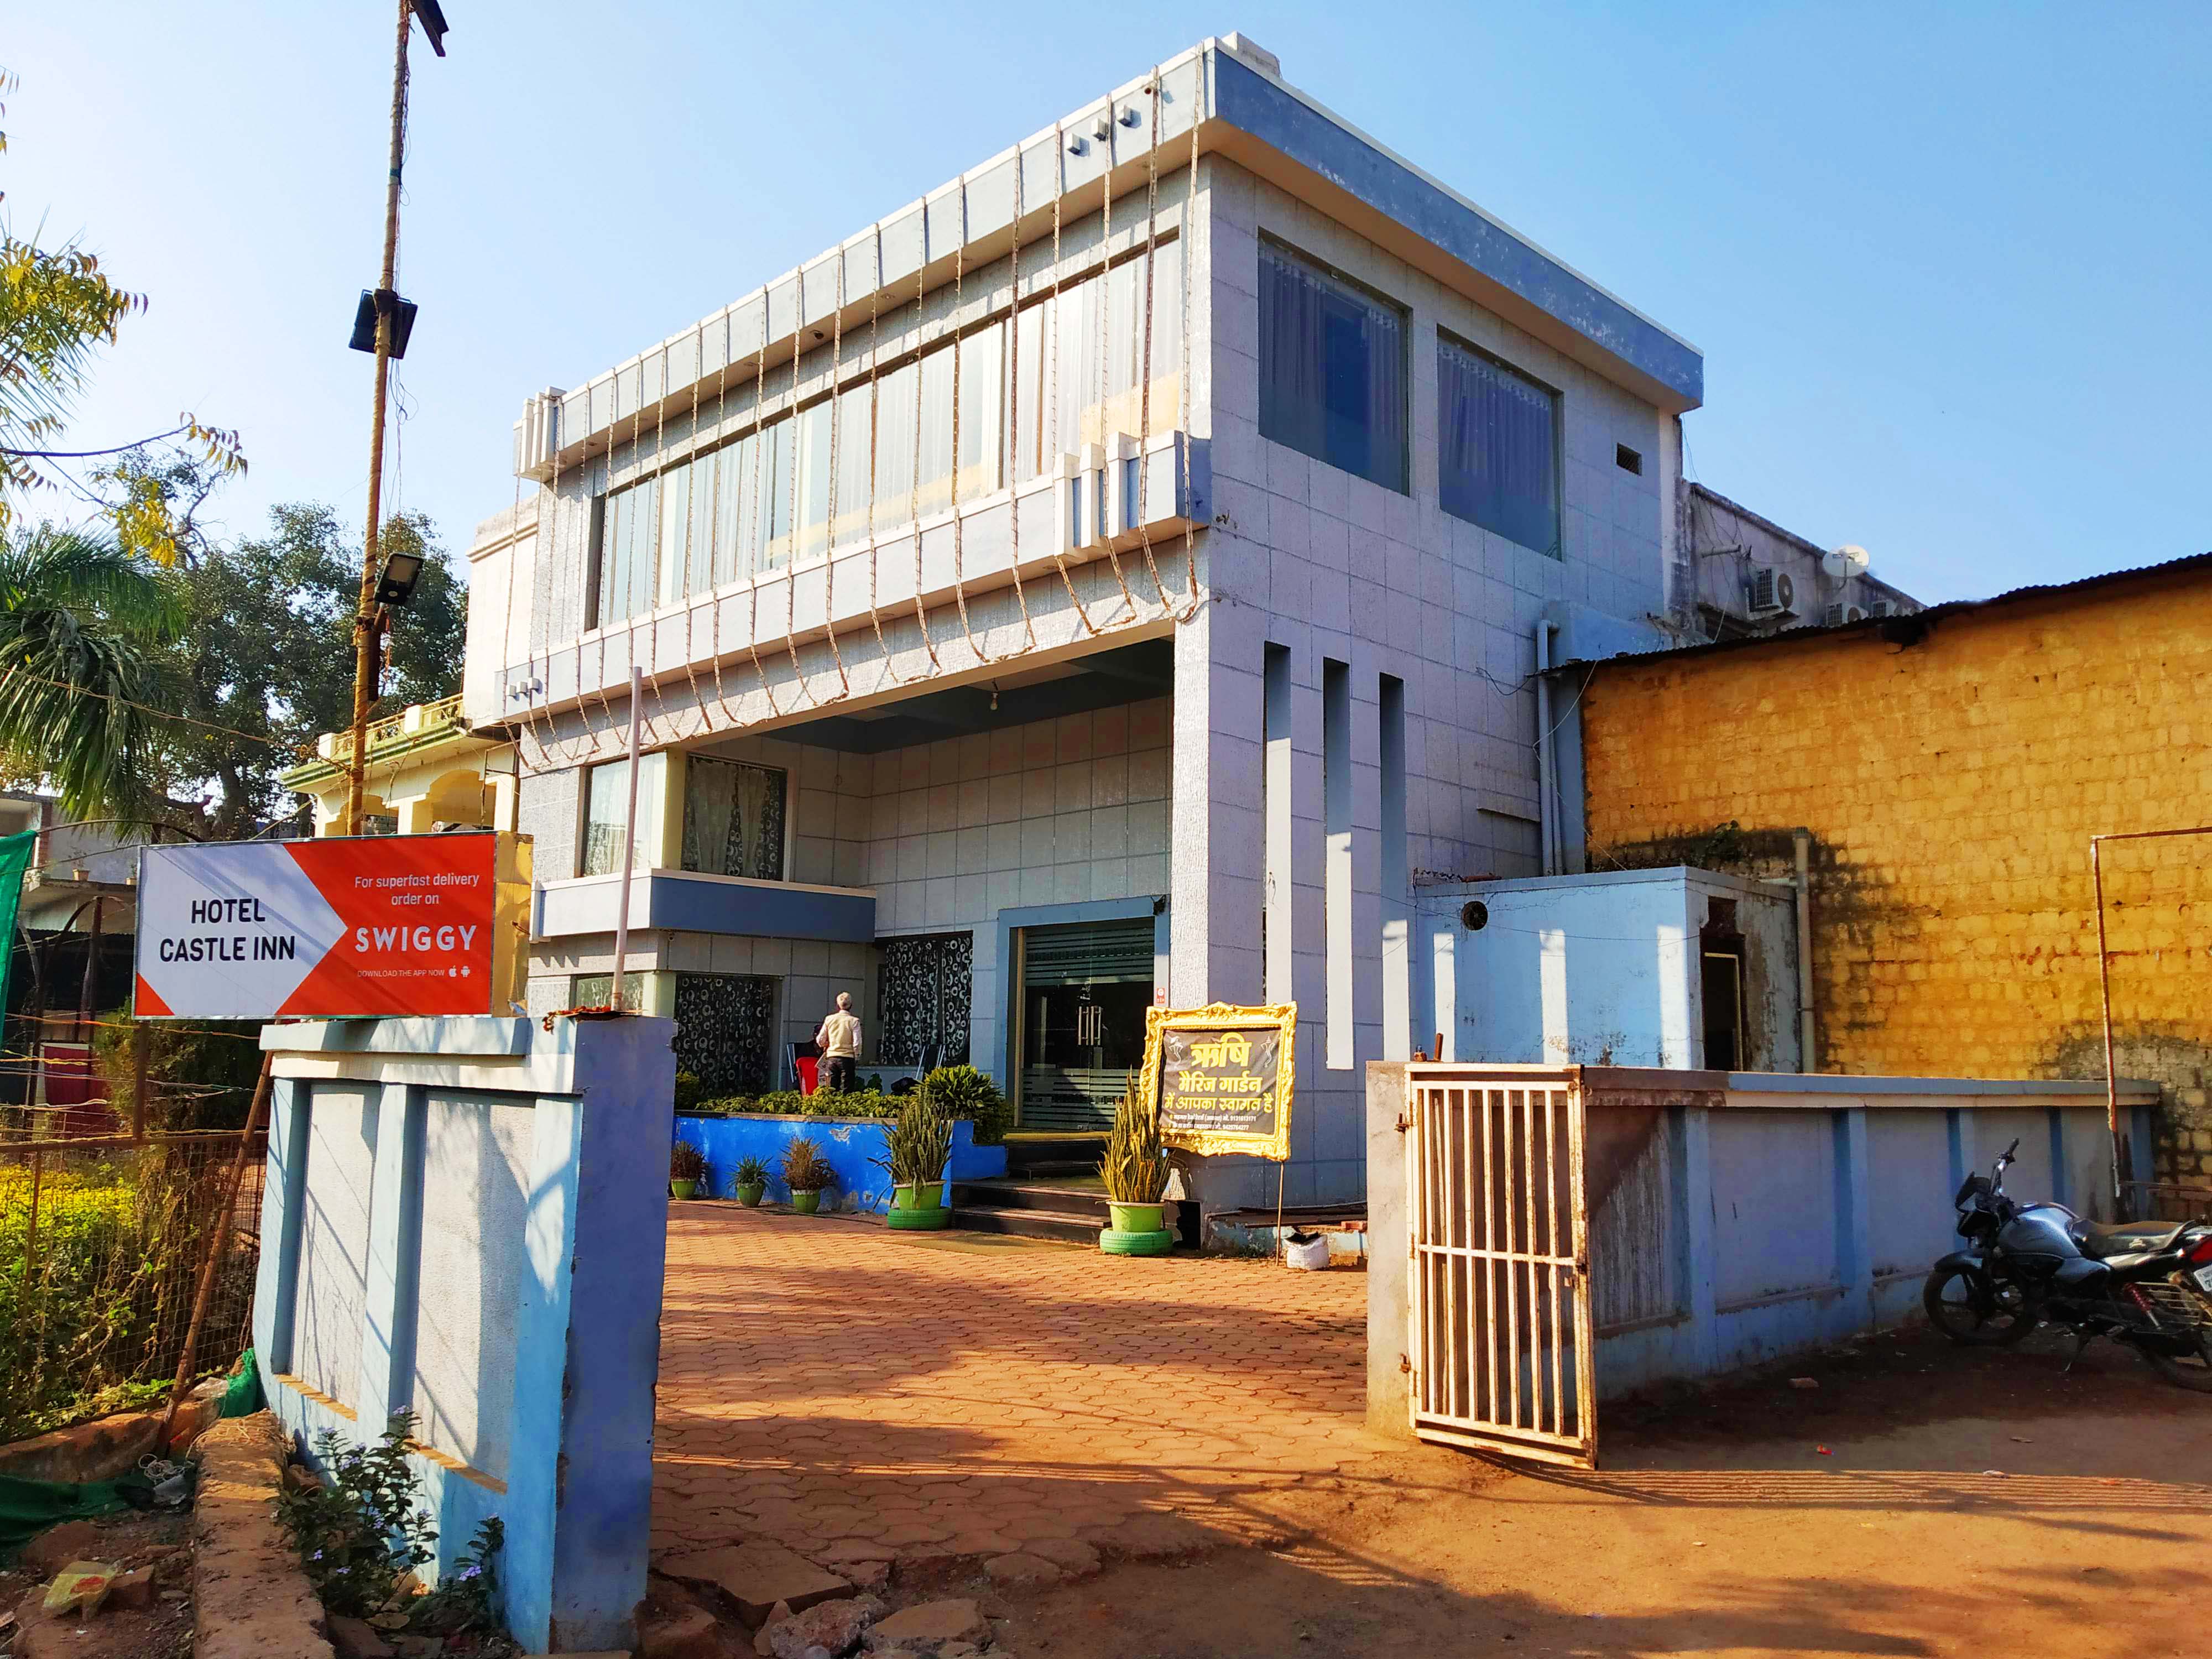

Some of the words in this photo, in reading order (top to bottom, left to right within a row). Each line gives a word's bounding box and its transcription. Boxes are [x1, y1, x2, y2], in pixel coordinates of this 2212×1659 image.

[354, 876, 373, 888] For
[376, 874, 430, 889] superfast
[433, 873, 479, 887] delivery
[391, 893, 422, 905] order
[425, 894, 439, 904] on
[191, 899, 265, 924] HOTEL
[160, 937, 246, 962] CASTLE
[253, 936, 295, 961] INN
[355, 925, 477, 952] SWIGGY
[1190, 1032, 1252, 1068] ऋषि
[1178, 1071, 1217, 1093] मैरिज
[1219, 1071, 1263, 1093] गार्डन
[1164, 1092, 1176, 1110] में
[1176, 1097, 1218, 1110] आपका
[1219, 1098, 1262, 1112] स्वागत
